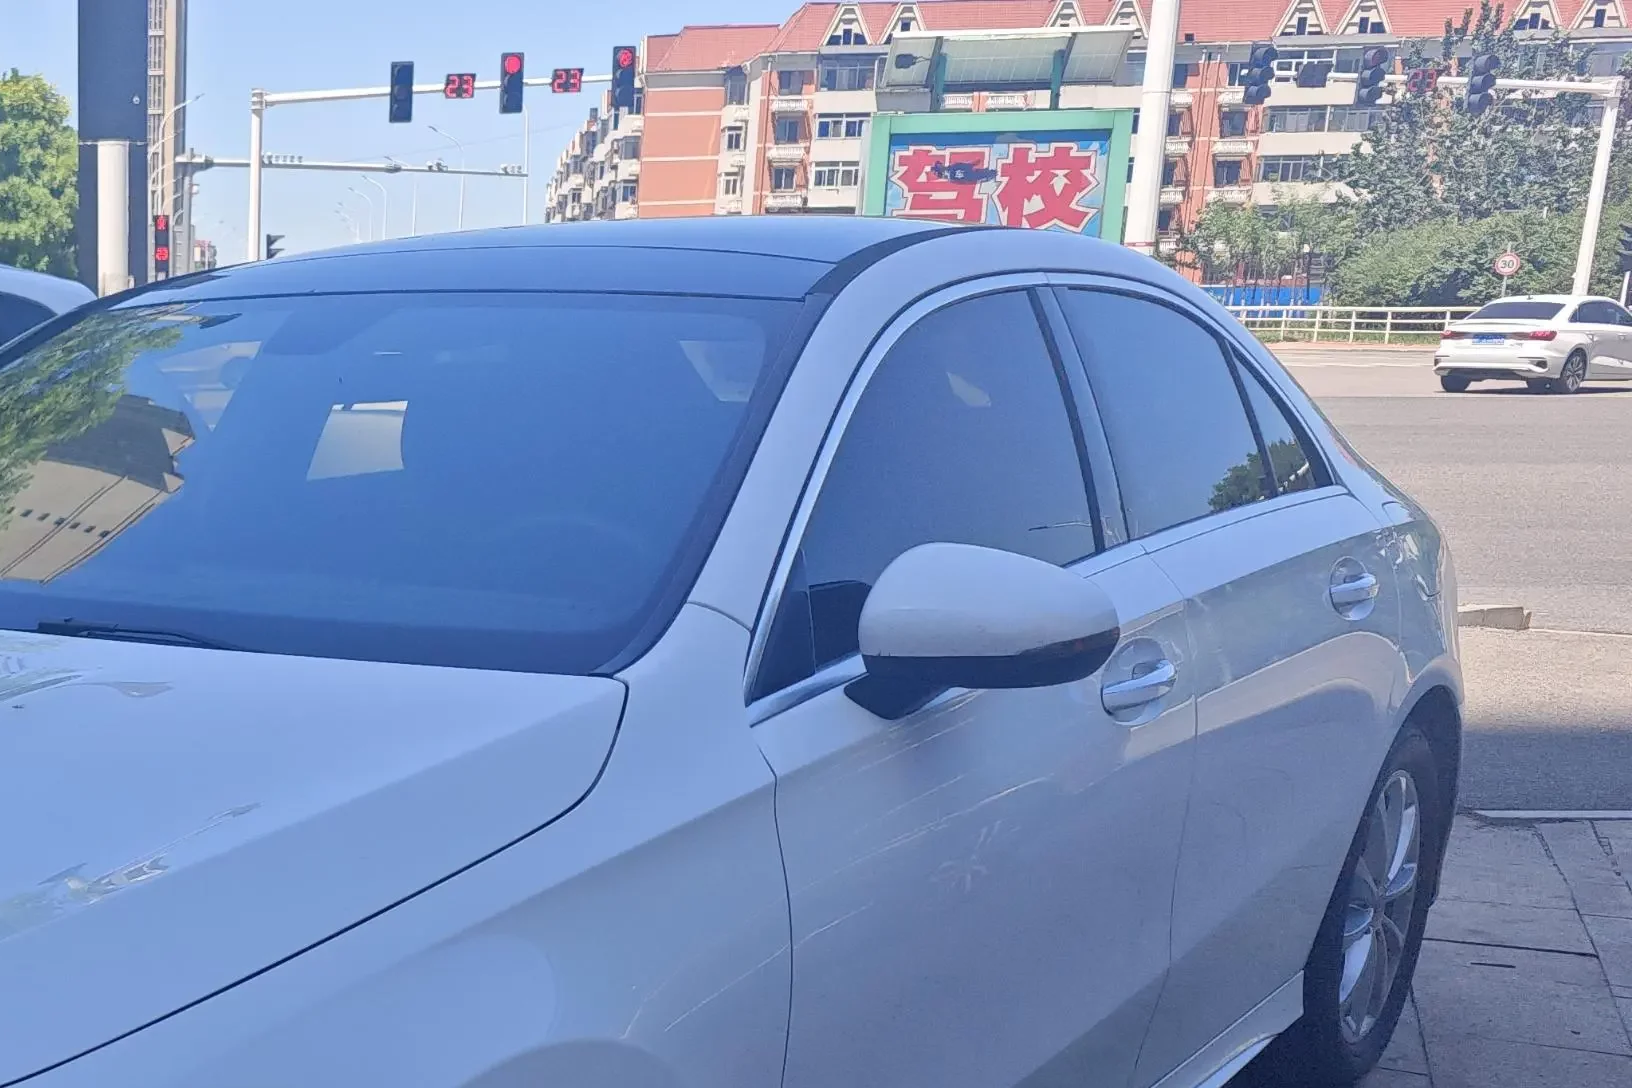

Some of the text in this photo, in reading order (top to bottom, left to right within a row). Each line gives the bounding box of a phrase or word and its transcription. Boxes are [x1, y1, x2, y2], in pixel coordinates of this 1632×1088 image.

[445, 76, 473, 98] 23
[554, 70, 581, 92] 23
[891, 143, 1099, 232] 驾校
[1500, 259, 1515, 269] 30
